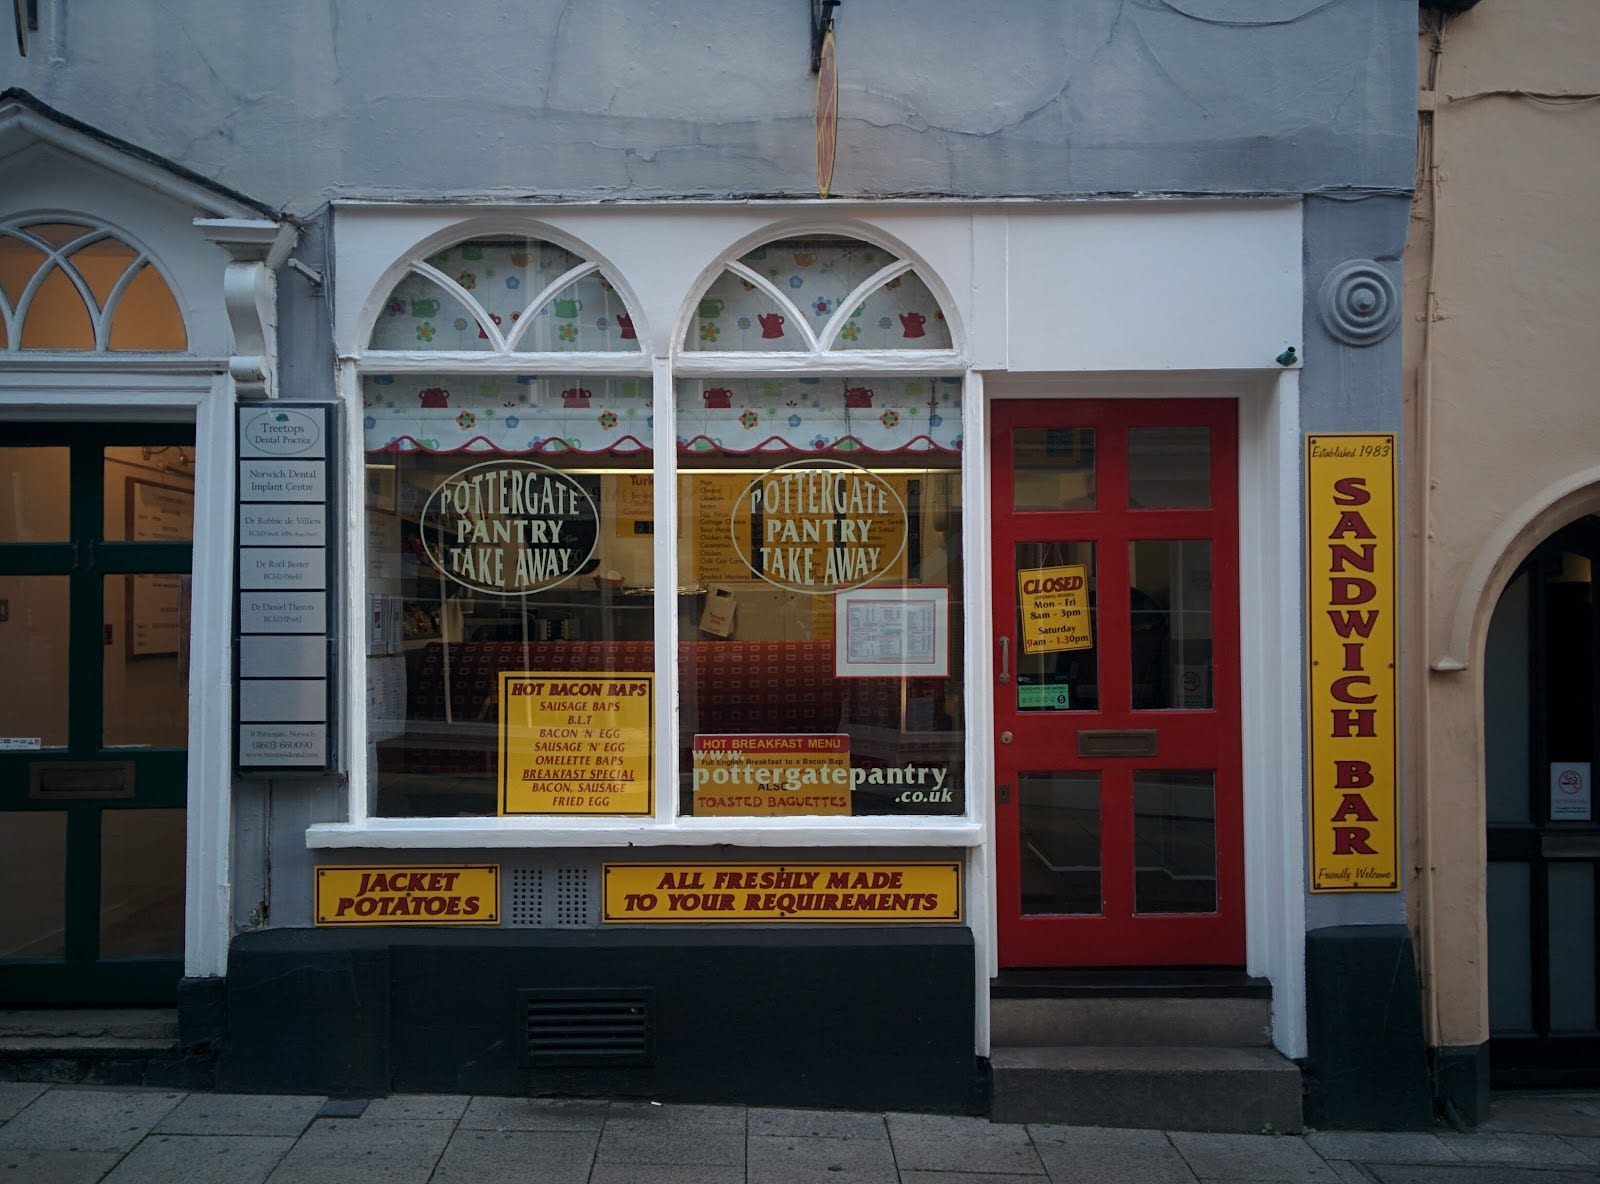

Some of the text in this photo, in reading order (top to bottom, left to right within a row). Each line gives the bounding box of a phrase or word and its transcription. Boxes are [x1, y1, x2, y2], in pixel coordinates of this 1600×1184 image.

[261, 422, 304, 436] Treetops
[255, 436, 311, 444] Dental Practice
[1312, 444, 1391, 459] Established 1983
[250, 469, 316, 479] Norwich Dental
[251, 482, 314, 493] Implant Centre
[440, 469, 580, 515] POTTERGATE
[750, 469, 888, 515] POTTERGATE
[457, 519, 564, 544] PANTRY
[767, 519, 872, 543] PANTRY
[450, 547, 572, 587] TAKE AWAY
[759, 547, 881, 586] TAKE AWAY
[1023, 575, 1084, 595] CLOSED
[1034, 601, 1055, 609] Mon
[1065, 598, 1076, 607] Fri
[1030, 611, 1050, 620] 8am
[1060, 609, 1081, 620] 3pm
[1038, 624, 1076, 635] Saturday
[1027, 638, 1046, 648] 9am
[1056, 634, 1089, 645] 1.30pm
[1327, 477, 1380, 856] SANDWICH BAR
[511, 683, 647, 696] HOT BACON BAPS
[539, 701, 620, 711] SAUSAGE BAPS
[567, 715, 593, 725] B.L.T
[539, 729, 578, 738] BACON
[599, 729, 620, 738] EGG
[534, 742, 582, 752] SAUSAGE
[604, 742, 625, 752] EGG
[703, 738, 841, 749] HOT BREAKFAST MENU
[535, 756, 624, 766] OMELETTE BAPS
[692, 749, 745, 761] www.
[522, 769, 635, 779] BREAKFAST SPECIAL
[692, 763, 947, 791] pottergatepantry
[532, 783, 626, 793] BACON, SAUSAGE
[552, 796, 610, 806] FRIED EGG
[698, 796, 847, 808] TOASTED BAGUETTES
[894, 788, 953, 803] .co.uk
[656, 871, 904, 890] ALL FRESHLY MADE
[1318, 867, 1392, 882] Friendly Welcome
[356, 872, 460, 897] JACKET
[335, 896, 480, 916] POTATOES
[624, 893, 938, 914] TO YOUR REQUIREMENTS
